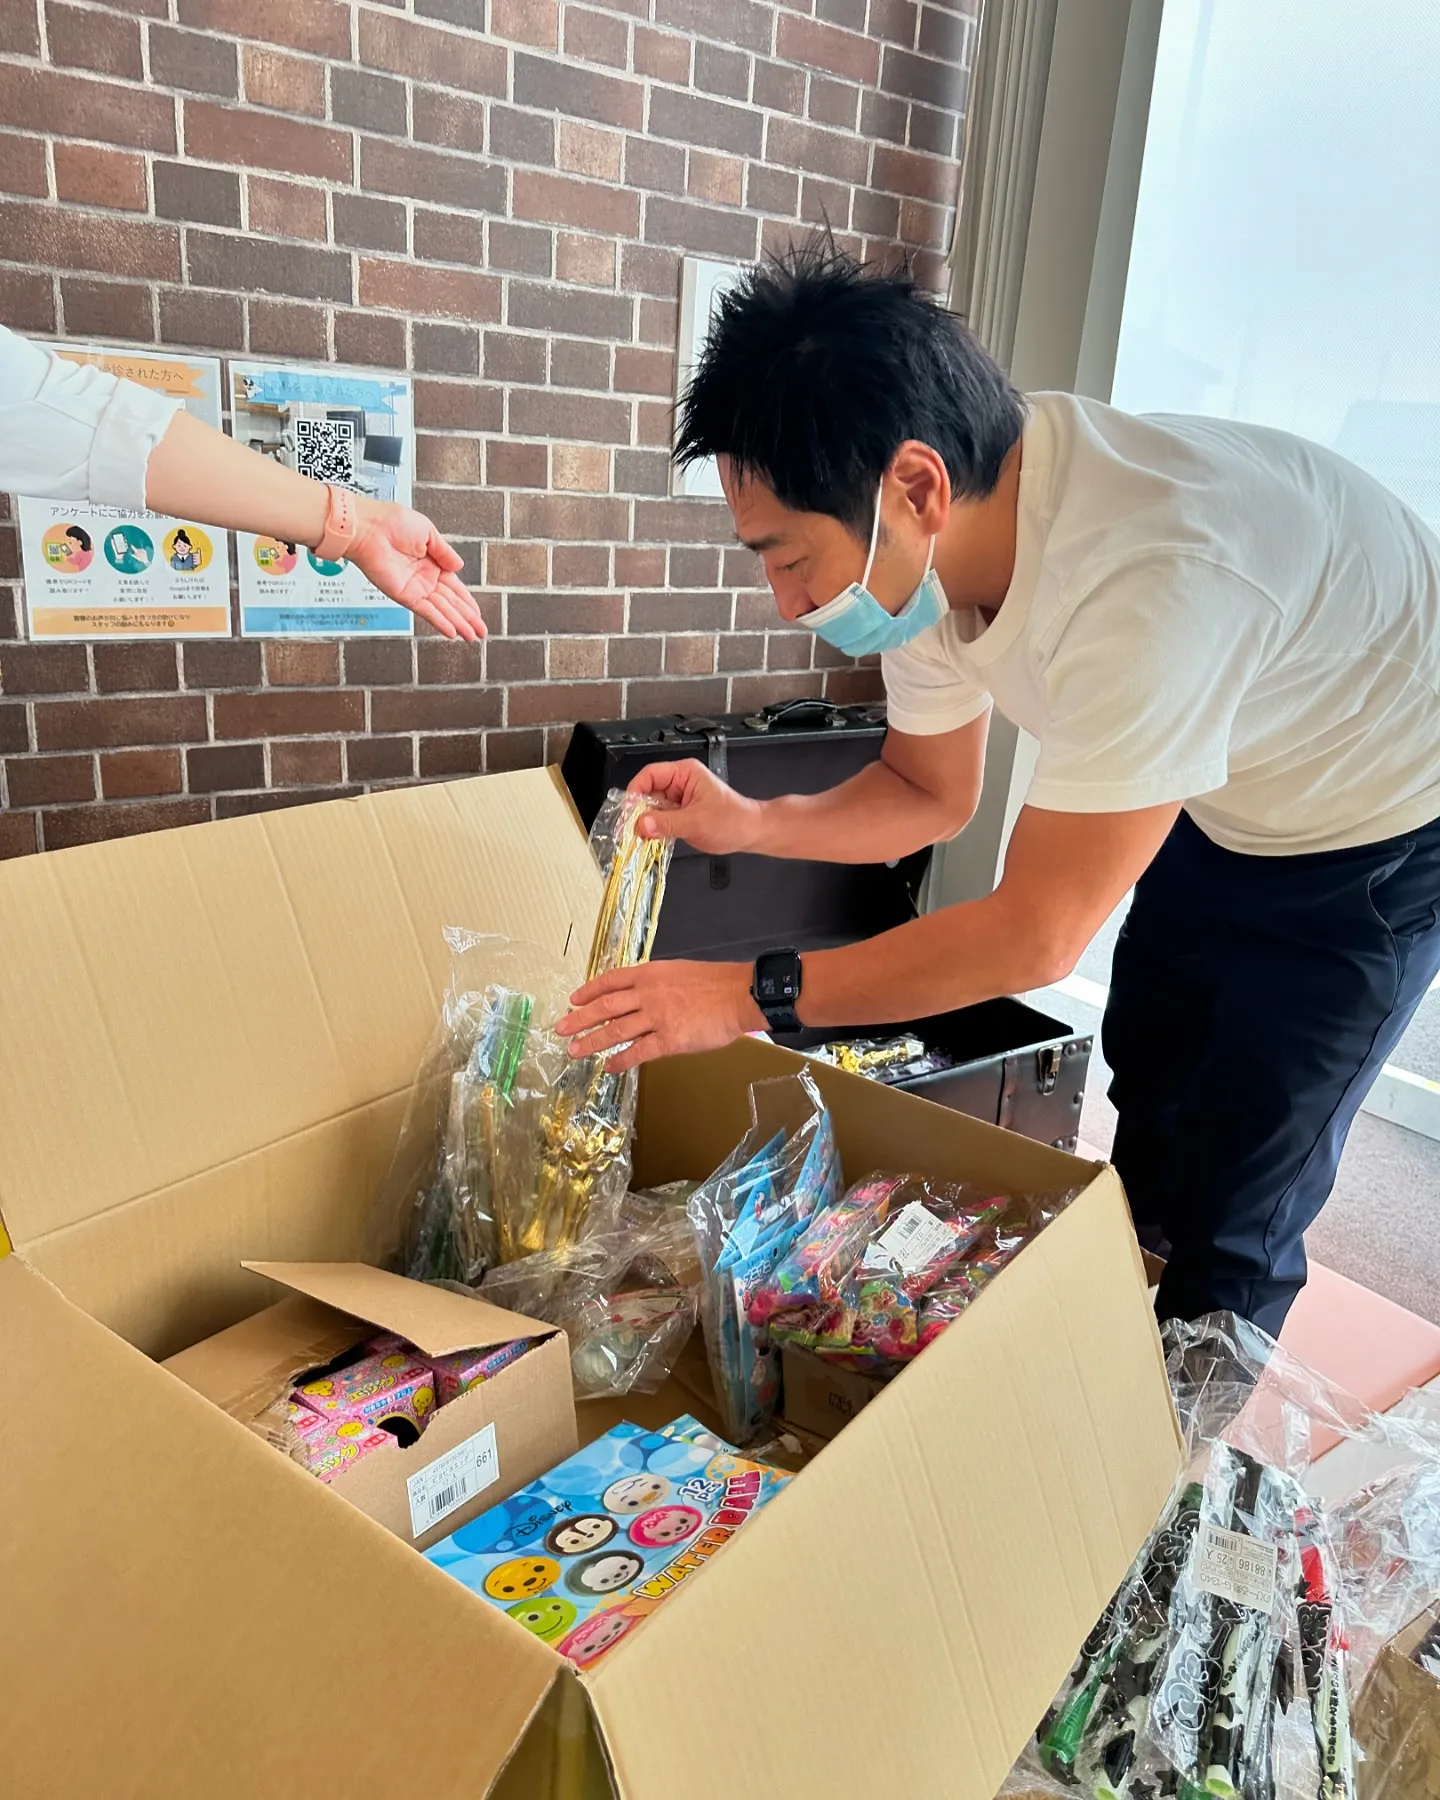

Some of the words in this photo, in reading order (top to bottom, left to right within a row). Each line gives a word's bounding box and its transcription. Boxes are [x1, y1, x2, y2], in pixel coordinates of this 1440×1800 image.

[475, 1447, 492, 1468] 661
[632, 1526, 737, 1600] WATER
[708, 1470, 763, 1528] BALL
[1216, 1551, 1227, 1564] 25
[1237, 1558, 1265, 1577] 88186
